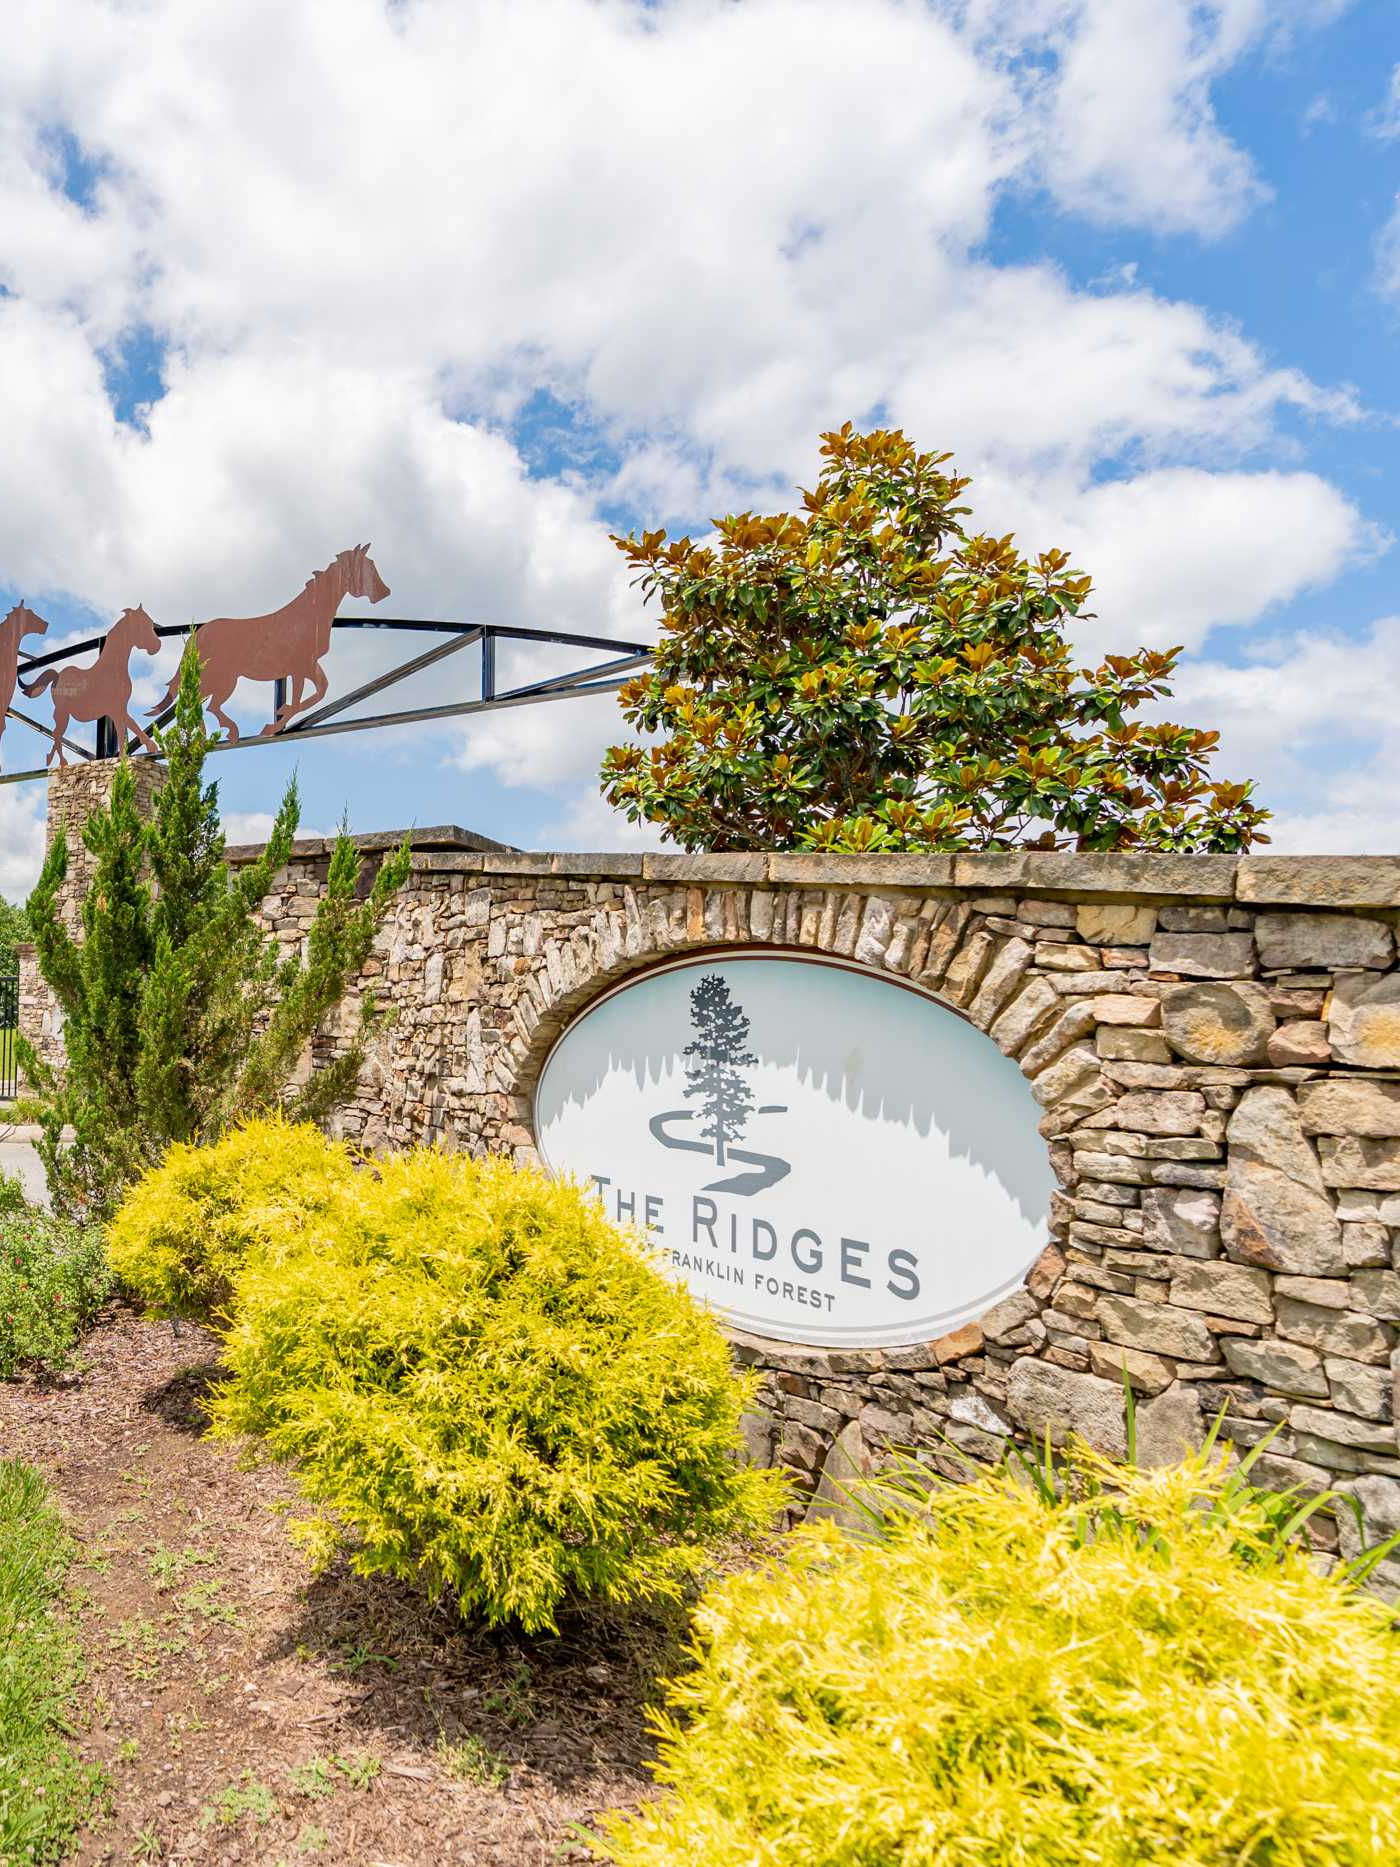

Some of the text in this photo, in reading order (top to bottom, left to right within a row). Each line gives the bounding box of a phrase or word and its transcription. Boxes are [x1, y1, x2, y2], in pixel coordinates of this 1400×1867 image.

[589, 1174, 921, 1301] THE RIDGES
[754, 1274, 836, 1313] FOREST
